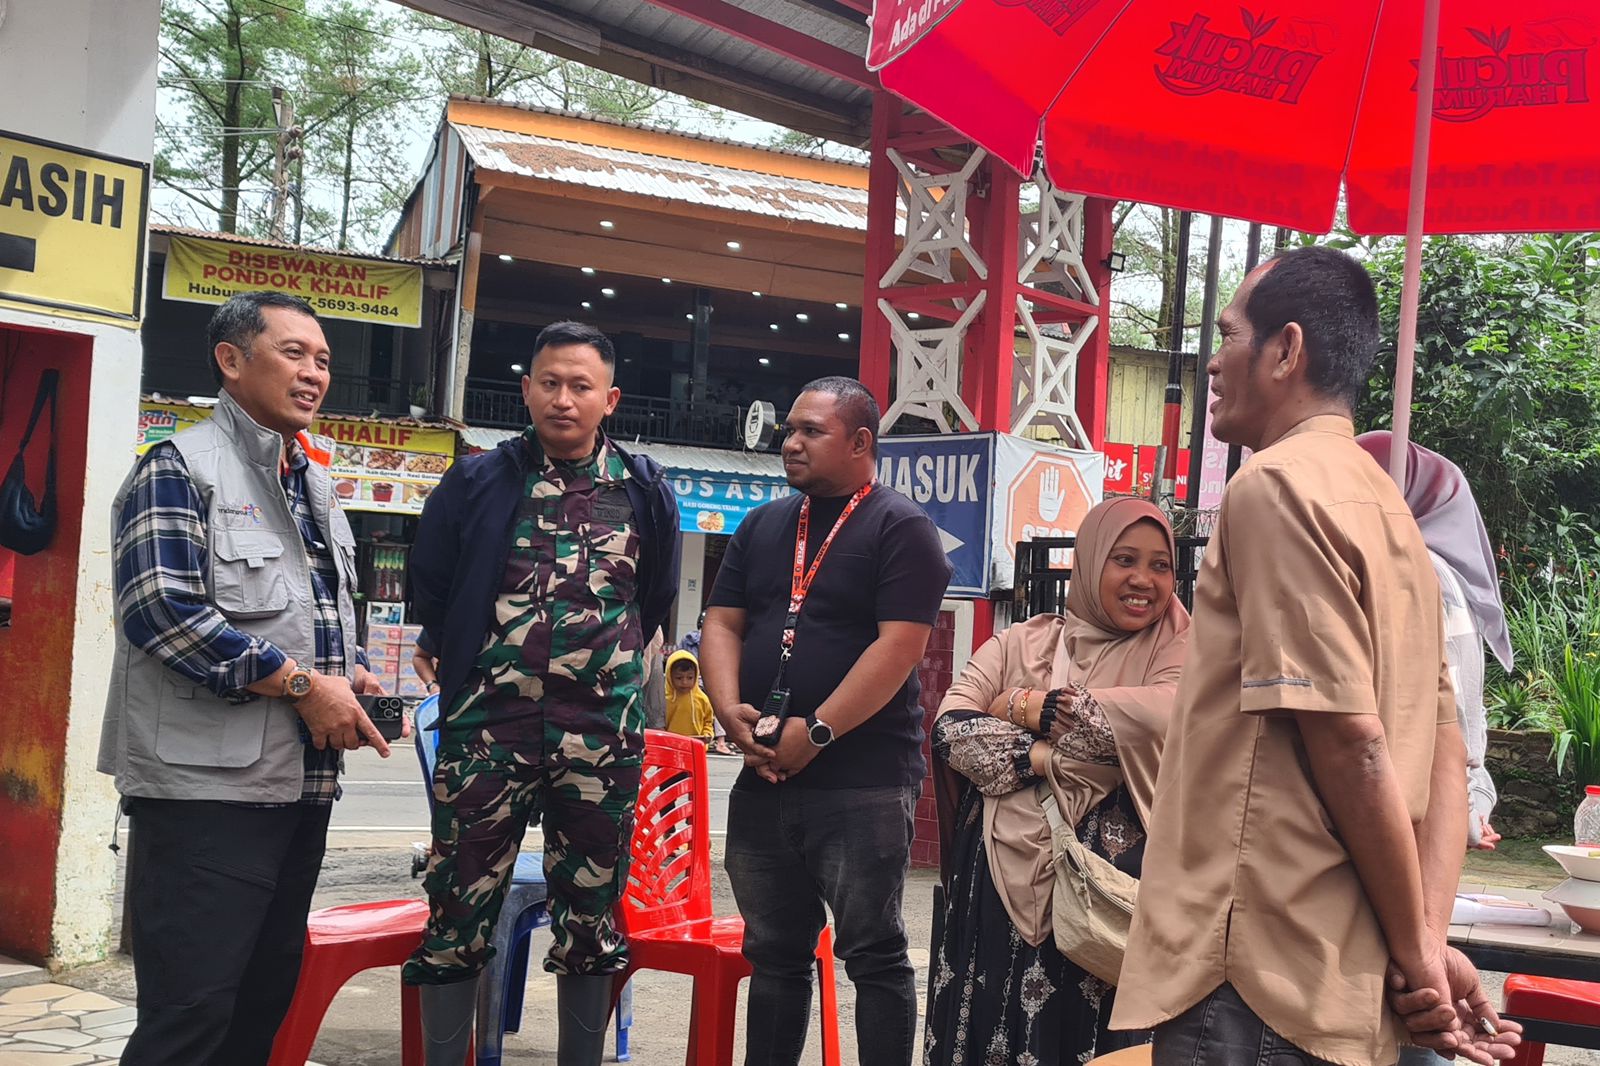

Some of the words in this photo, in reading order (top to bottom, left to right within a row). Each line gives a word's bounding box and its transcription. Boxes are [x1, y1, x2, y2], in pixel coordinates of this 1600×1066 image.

[889, 7, 917, 52] Ada
[0, 152, 124, 229] ASIH
[203, 264, 301, 290] PONDOK
[310, 277, 390, 300] KHALIF
[228, 250, 367, 282] DISEWAKAN
[295, 294, 399, 317] 7-5693-9484
[319, 422, 413, 446] KHALIF
